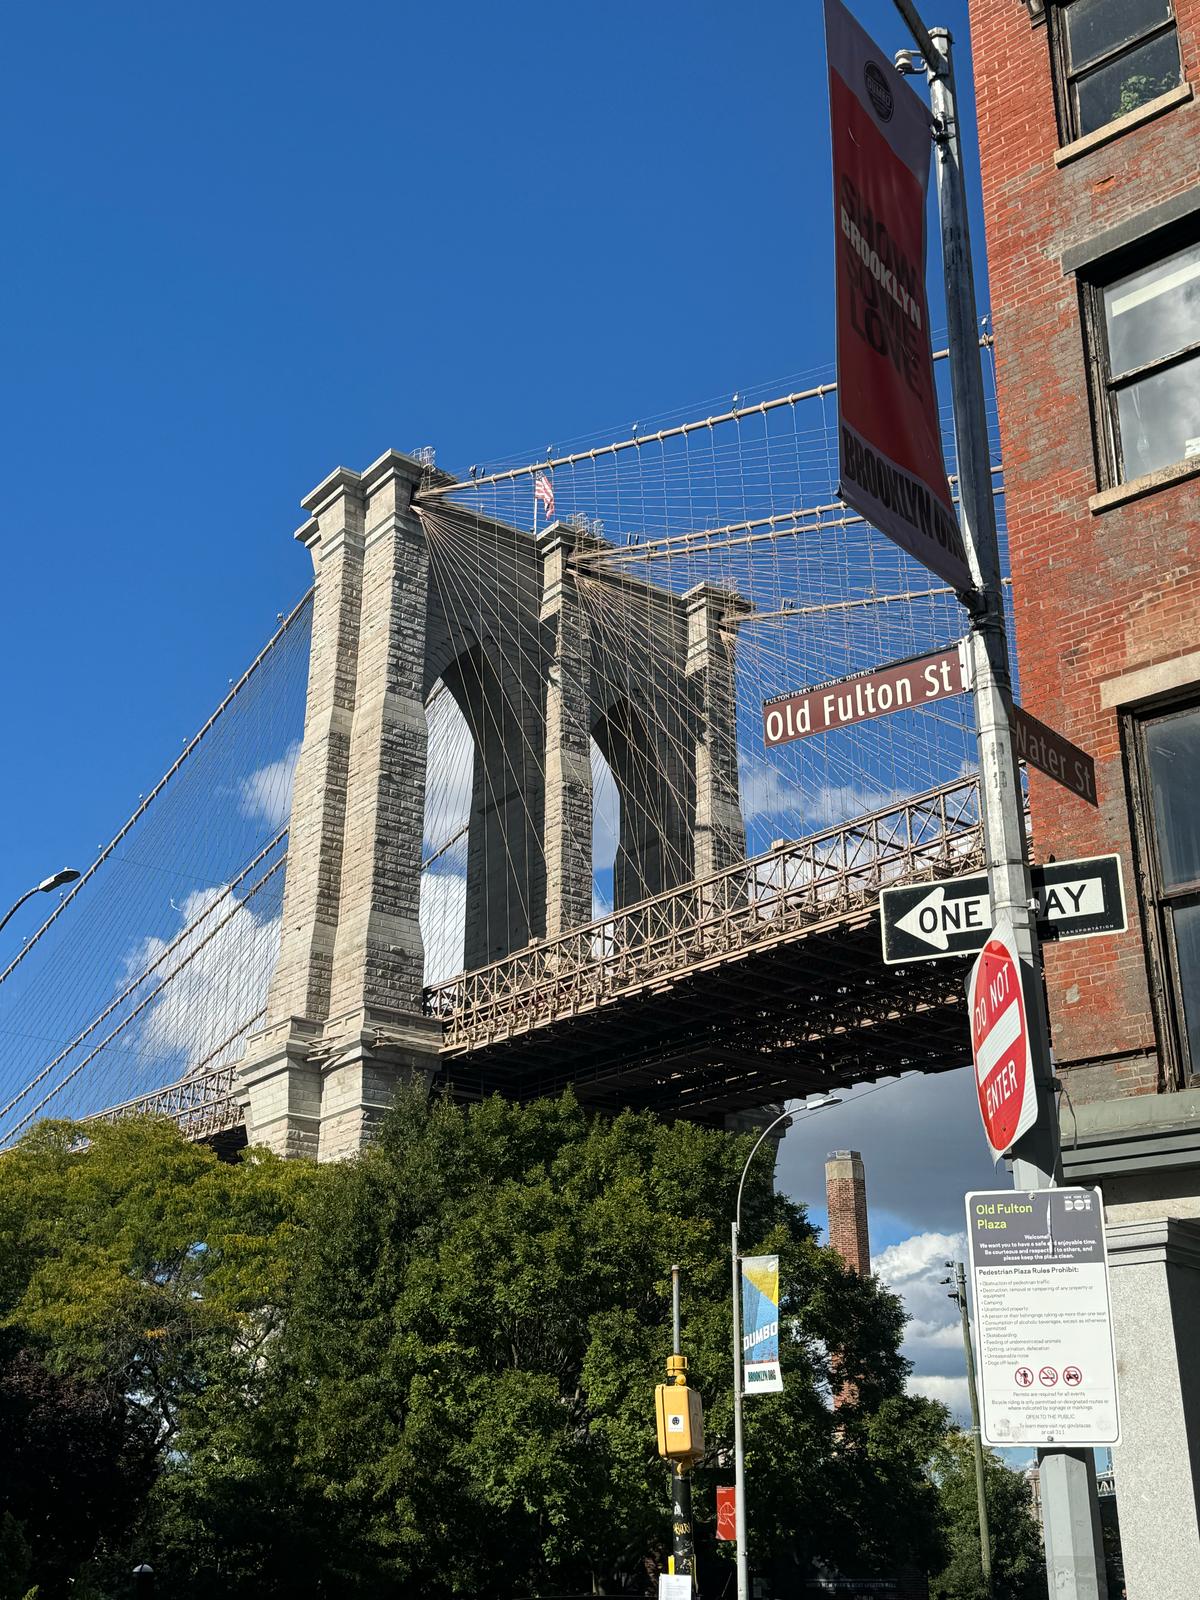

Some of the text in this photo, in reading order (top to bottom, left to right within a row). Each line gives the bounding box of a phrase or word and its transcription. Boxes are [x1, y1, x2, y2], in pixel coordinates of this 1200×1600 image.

[841, 204, 921, 331] BROOKLYN
[850, 287, 923, 404] LOVE
[842, 425, 934, 539] BROOKLYN
[765, 668, 876, 705] FULTON FERRY HISTORIC DISTRICT
[766, 660, 953, 741] Old Fulton St
[1074, 761, 1092, 797] St
[919, 884, 1087, 934] ONE AY
[975, 962, 1010, 1036] DO NOT
[986, 1060, 1018, 1119] ENTER
[976, 1204, 1032, 1214] Old Fulton
[978, 1220, 1007, 1229] Plaza
[1065, 1199, 1091, 1211] DOT
[744, 1321, 778, 1351] DUMBO
